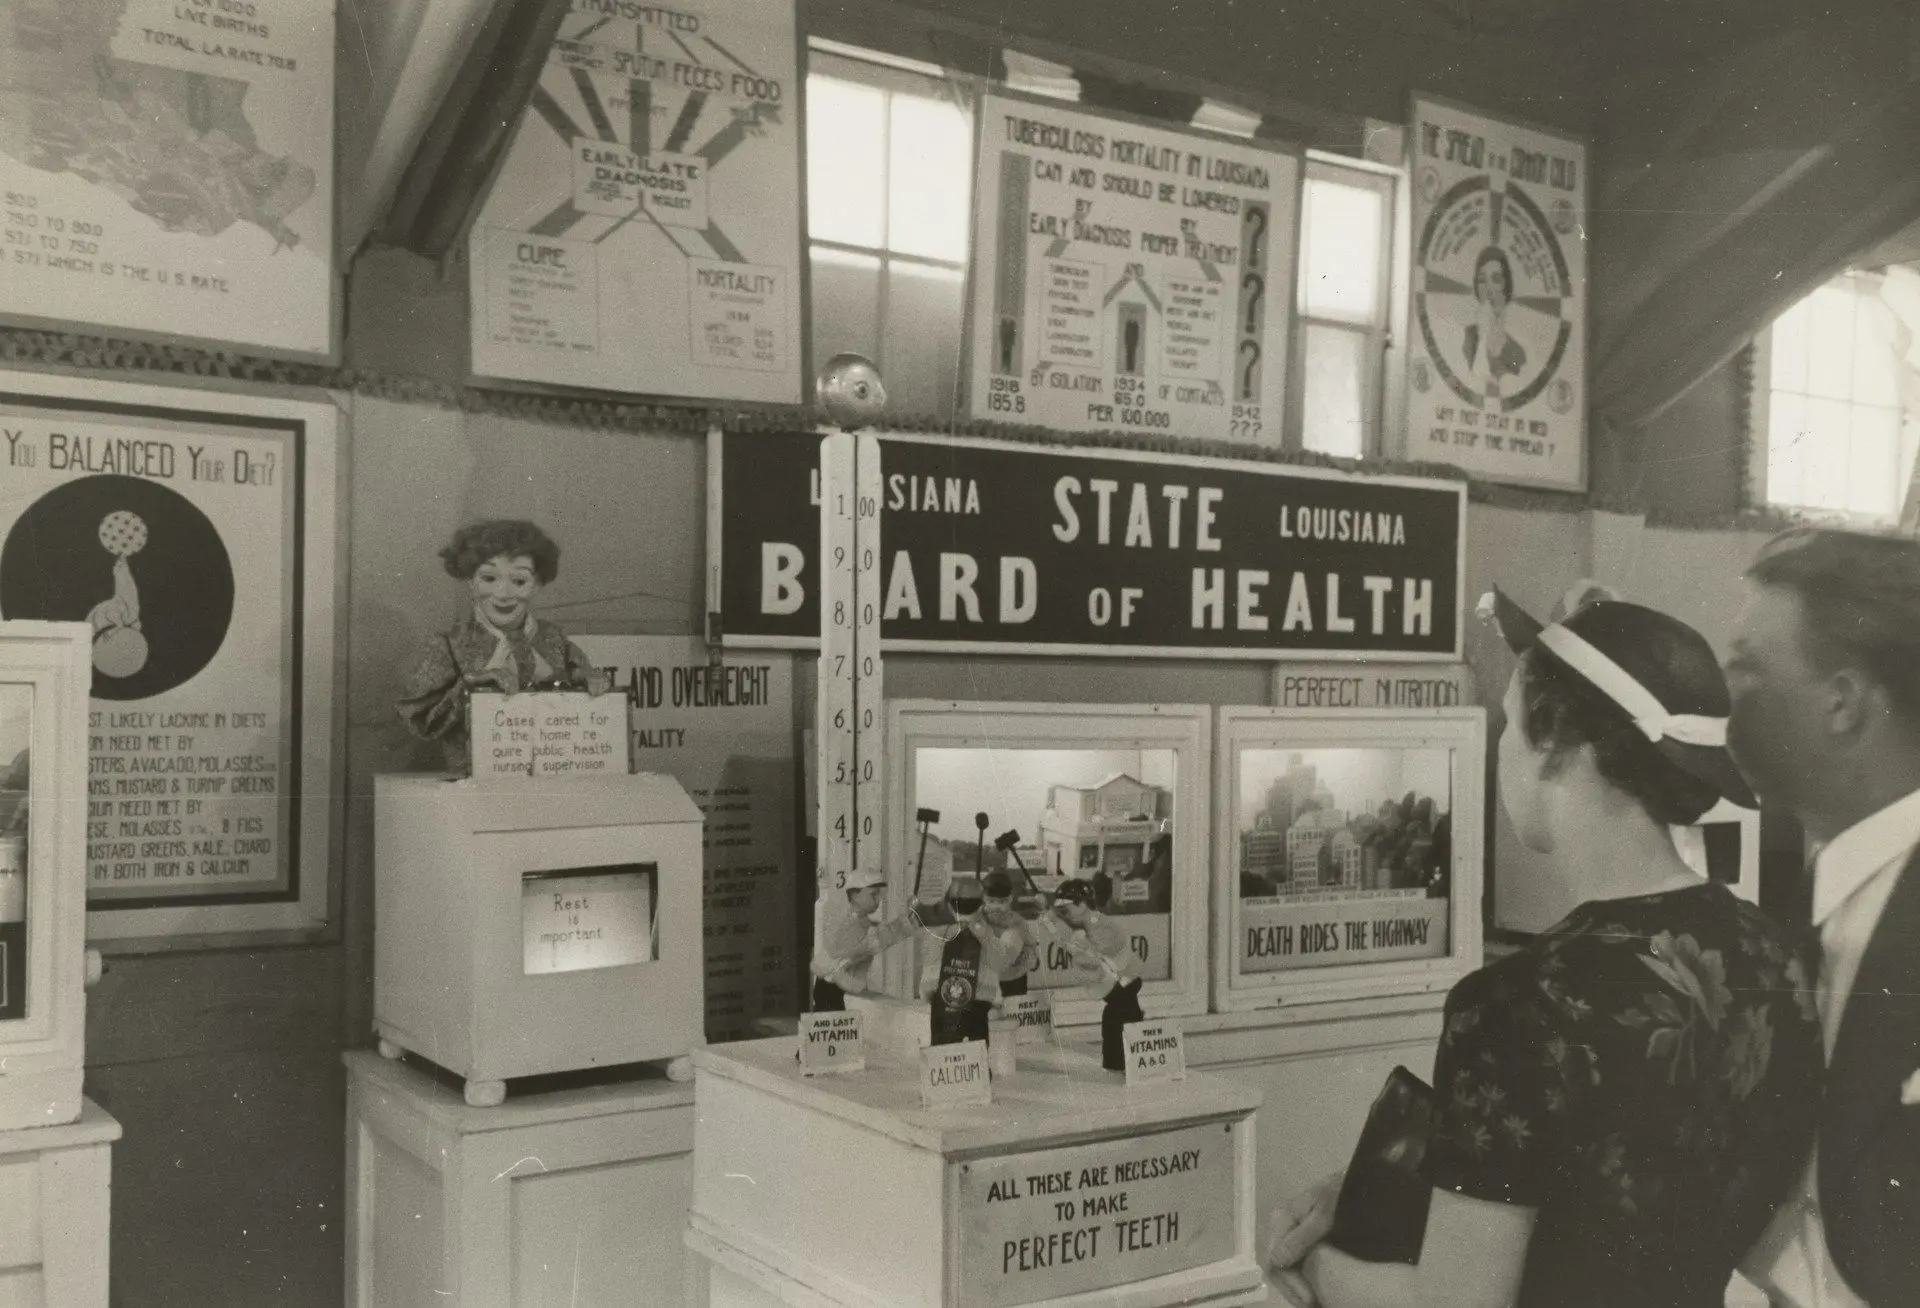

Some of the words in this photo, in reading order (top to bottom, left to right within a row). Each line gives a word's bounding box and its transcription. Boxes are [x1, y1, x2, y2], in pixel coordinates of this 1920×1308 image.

[213, 15, 269, 39] BIRTHS
[142, 28, 196, 52] TOTAL
[674, 63, 724, 91] FECES
[732, 74, 781, 101] FOOD
[581, 148, 636, 169] EARLY
[645, 159, 699, 180] LATE
[1005, 116, 1105, 159] TUBERCULOSIS
[1110, 139, 1181, 173] MORTALITY
[1187, 152, 1201, 178] IN
[1206, 156, 1270, 191] LOUISIANA
[595, 167, 687, 192] DIAGNOSIS
[1035, 159, 1062, 182] CAN
[1069, 167, 1096, 189] AND
[1103, 172, 1152, 200] SHOULD
[46, 216, 65, 232] TO
[1030, 212, 1069, 237] EARLY
[1073, 219, 1131, 248] DIAGNOSIS
[40, 234, 59, 250] TO
[517, 243, 567, 270] CURE
[121, 264, 150, 282] THE
[191, 275, 229, 293] RATE
[696, 267, 777, 295] MORTALITY
[990, 378, 1020, 393] 1918
[1114, 377, 1145, 392] 1934
[1087, 403, 1113, 422] PER
[50, 433, 175, 478] BALANCED
[1052, 475, 1224, 551] STATE
[1280, 505, 1406, 546] LOUISIANA
[761, 541, 1039, 625] BARD
[1088, 587, 1143, 628] OF
[1191, 567, 1433, 636] HEALTH
[630, 667, 663, 708] AND
[1284, 675, 1364, 707] PERFECT
[1376, 678, 1460, 707] NUTRITION
[88, 712, 101, 729] ST
[110, 712, 155, 729] LIKELY
[160, 712, 209, 729] LACKING
[214, 712, 226, 729] IN
[231, 712, 266, 729] DIETS
[494, 709, 535, 727] Cases
[545, 711, 580, 726] cared
[590, 711, 610, 726] for
[110, 735, 141, 751] NEED
[147, 735, 172, 751] MET
[178, 735, 194, 751] BY
[492, 729, 502, 742] in
[510, 729, 529, 742] the
[539, 728, 572, 742] home
[632, 727, 687, 748] TALITY
[532, 743, 565, 760] public
[573, 742, 612, 756] health
[493, 760, 534, 777] nursing
[543, 759, 605, 775] supervision
[116, 778, 167, 796] MUSTARD
[186, 777, 226, 794] TURNIP
[231, 775, 276, 794] GREENS
[119, 800, 151, 817] NEED
[157, 799, 179, 816] MET
[187, 799, 202, 815] BY
[119, 820, 182, 837] MOLASSES
[237, 817, 264, 834] FIGS
[234, 838, 271, 855] CHARD
[94, 863, 107, 880] IN
[113, 862, 147, 880] BOTH
[154, 861, 180, 878] IRON
[200, 859, 249, 876] CALCIUM
[554, 893, 590, 912] Rest
[540, 927, 602, 949] important
[1247, 925, 1293, 958] DEATH
[1300, 921, 1339, 955] RIDES
[1344, 920, 1368, 951] THE
[1372, 917, 1432, 949] HIGHWAY
[813, 1019, 830, 1028] AND
[833, 1017, 854, 1028] LAST
[1142, 1028, 1162, 1036] THEN
[808, 1028, 858, 1043] VITAMIN
[1130, 1036, 1177, 1053] VITAMINS
[828, 1045, 836, 1057] D
[1138, 1057, 1146, 1068] A
[930, 1063, 981, 1087] CALCIUM
[987, 1178, 1021, 1203] ALL
[1026, 1171, 1072, 1197] THESE
[1078, 1165, 1109, 1190] ARE
[1115, 1149, 1201, 1184] NECESSARY
[1055, 1201, 1075, 1221] TO
[1083, 1192, 1128, 1218] MAKE
[1002, 1226, 1101, 1274] PERFECT
[1115, 1211, 1180, 1253] TEETH
